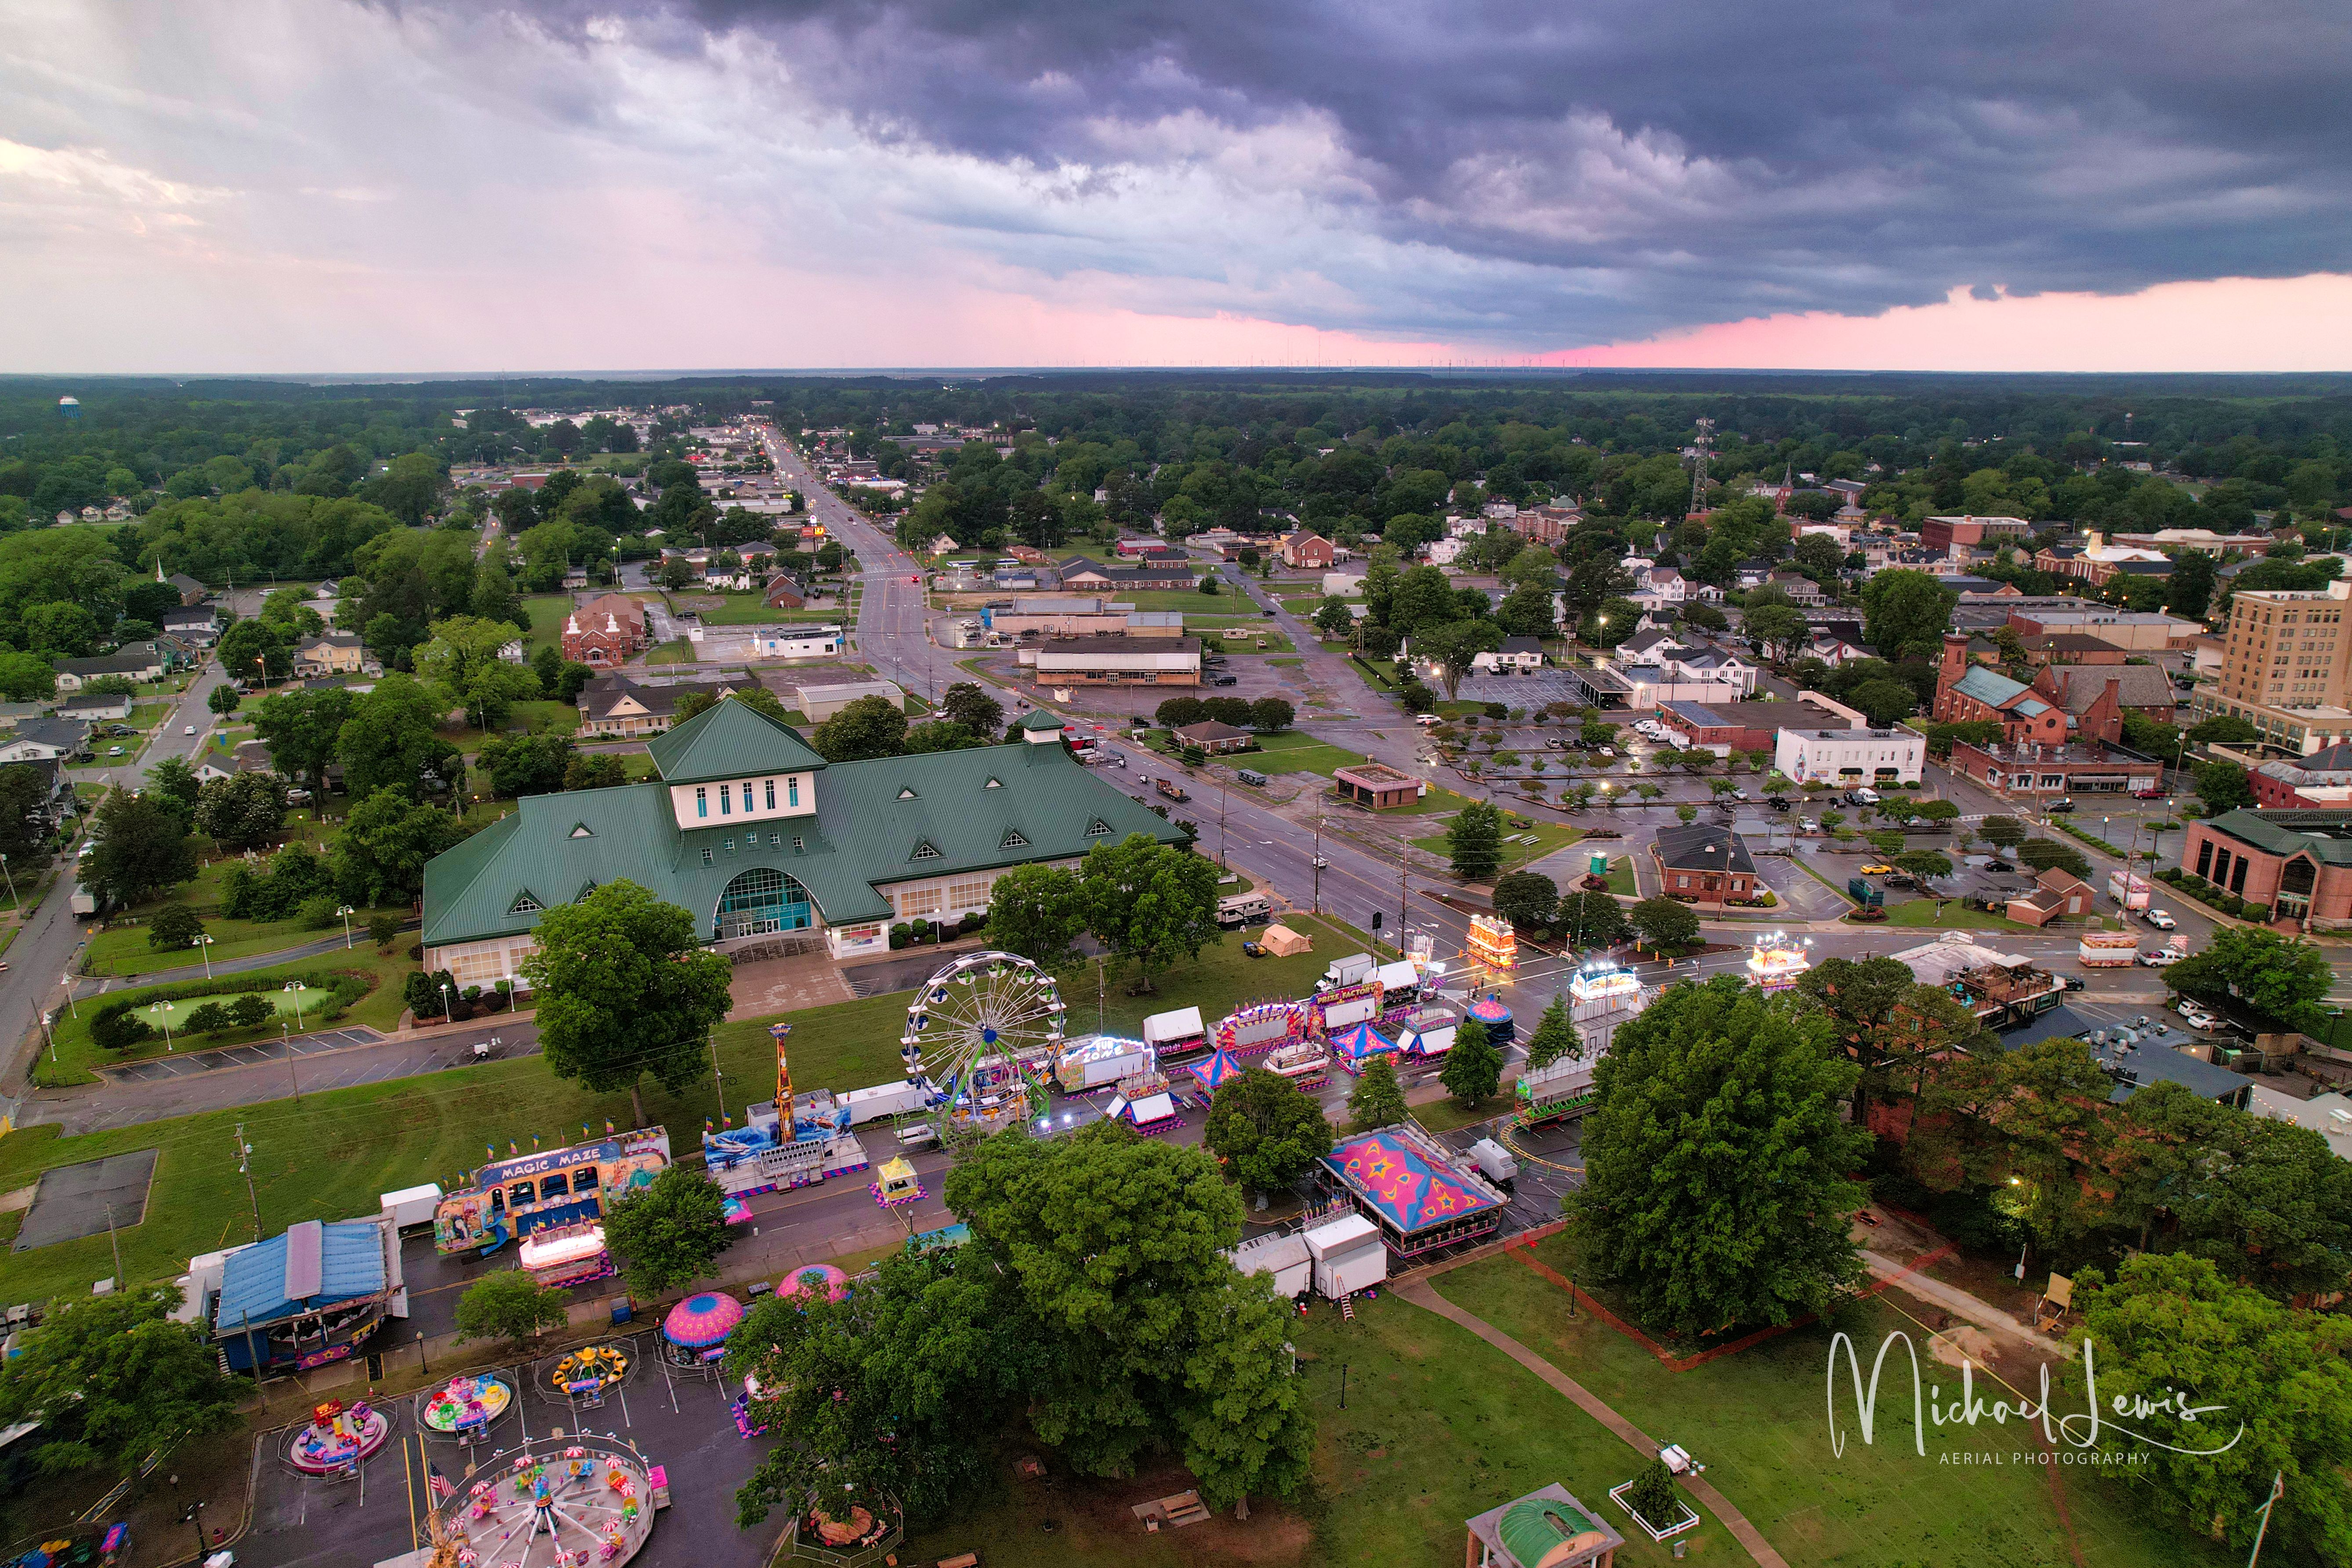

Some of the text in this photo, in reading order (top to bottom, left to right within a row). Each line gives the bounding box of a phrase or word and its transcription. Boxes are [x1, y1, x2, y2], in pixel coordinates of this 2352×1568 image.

[1317, 986, 1376, 1004] PRIZE FACTORY
[1240, 1015, 1259, 1024] MACHINE
[1083, 1045, 1123, 1063] ZONE
[1096, 1040, 1113, 1051] FUN
[502, 1148, 601, 1179] MAGIC MAZE
[1343, 1167, 1370, 1192] SCOOTER
